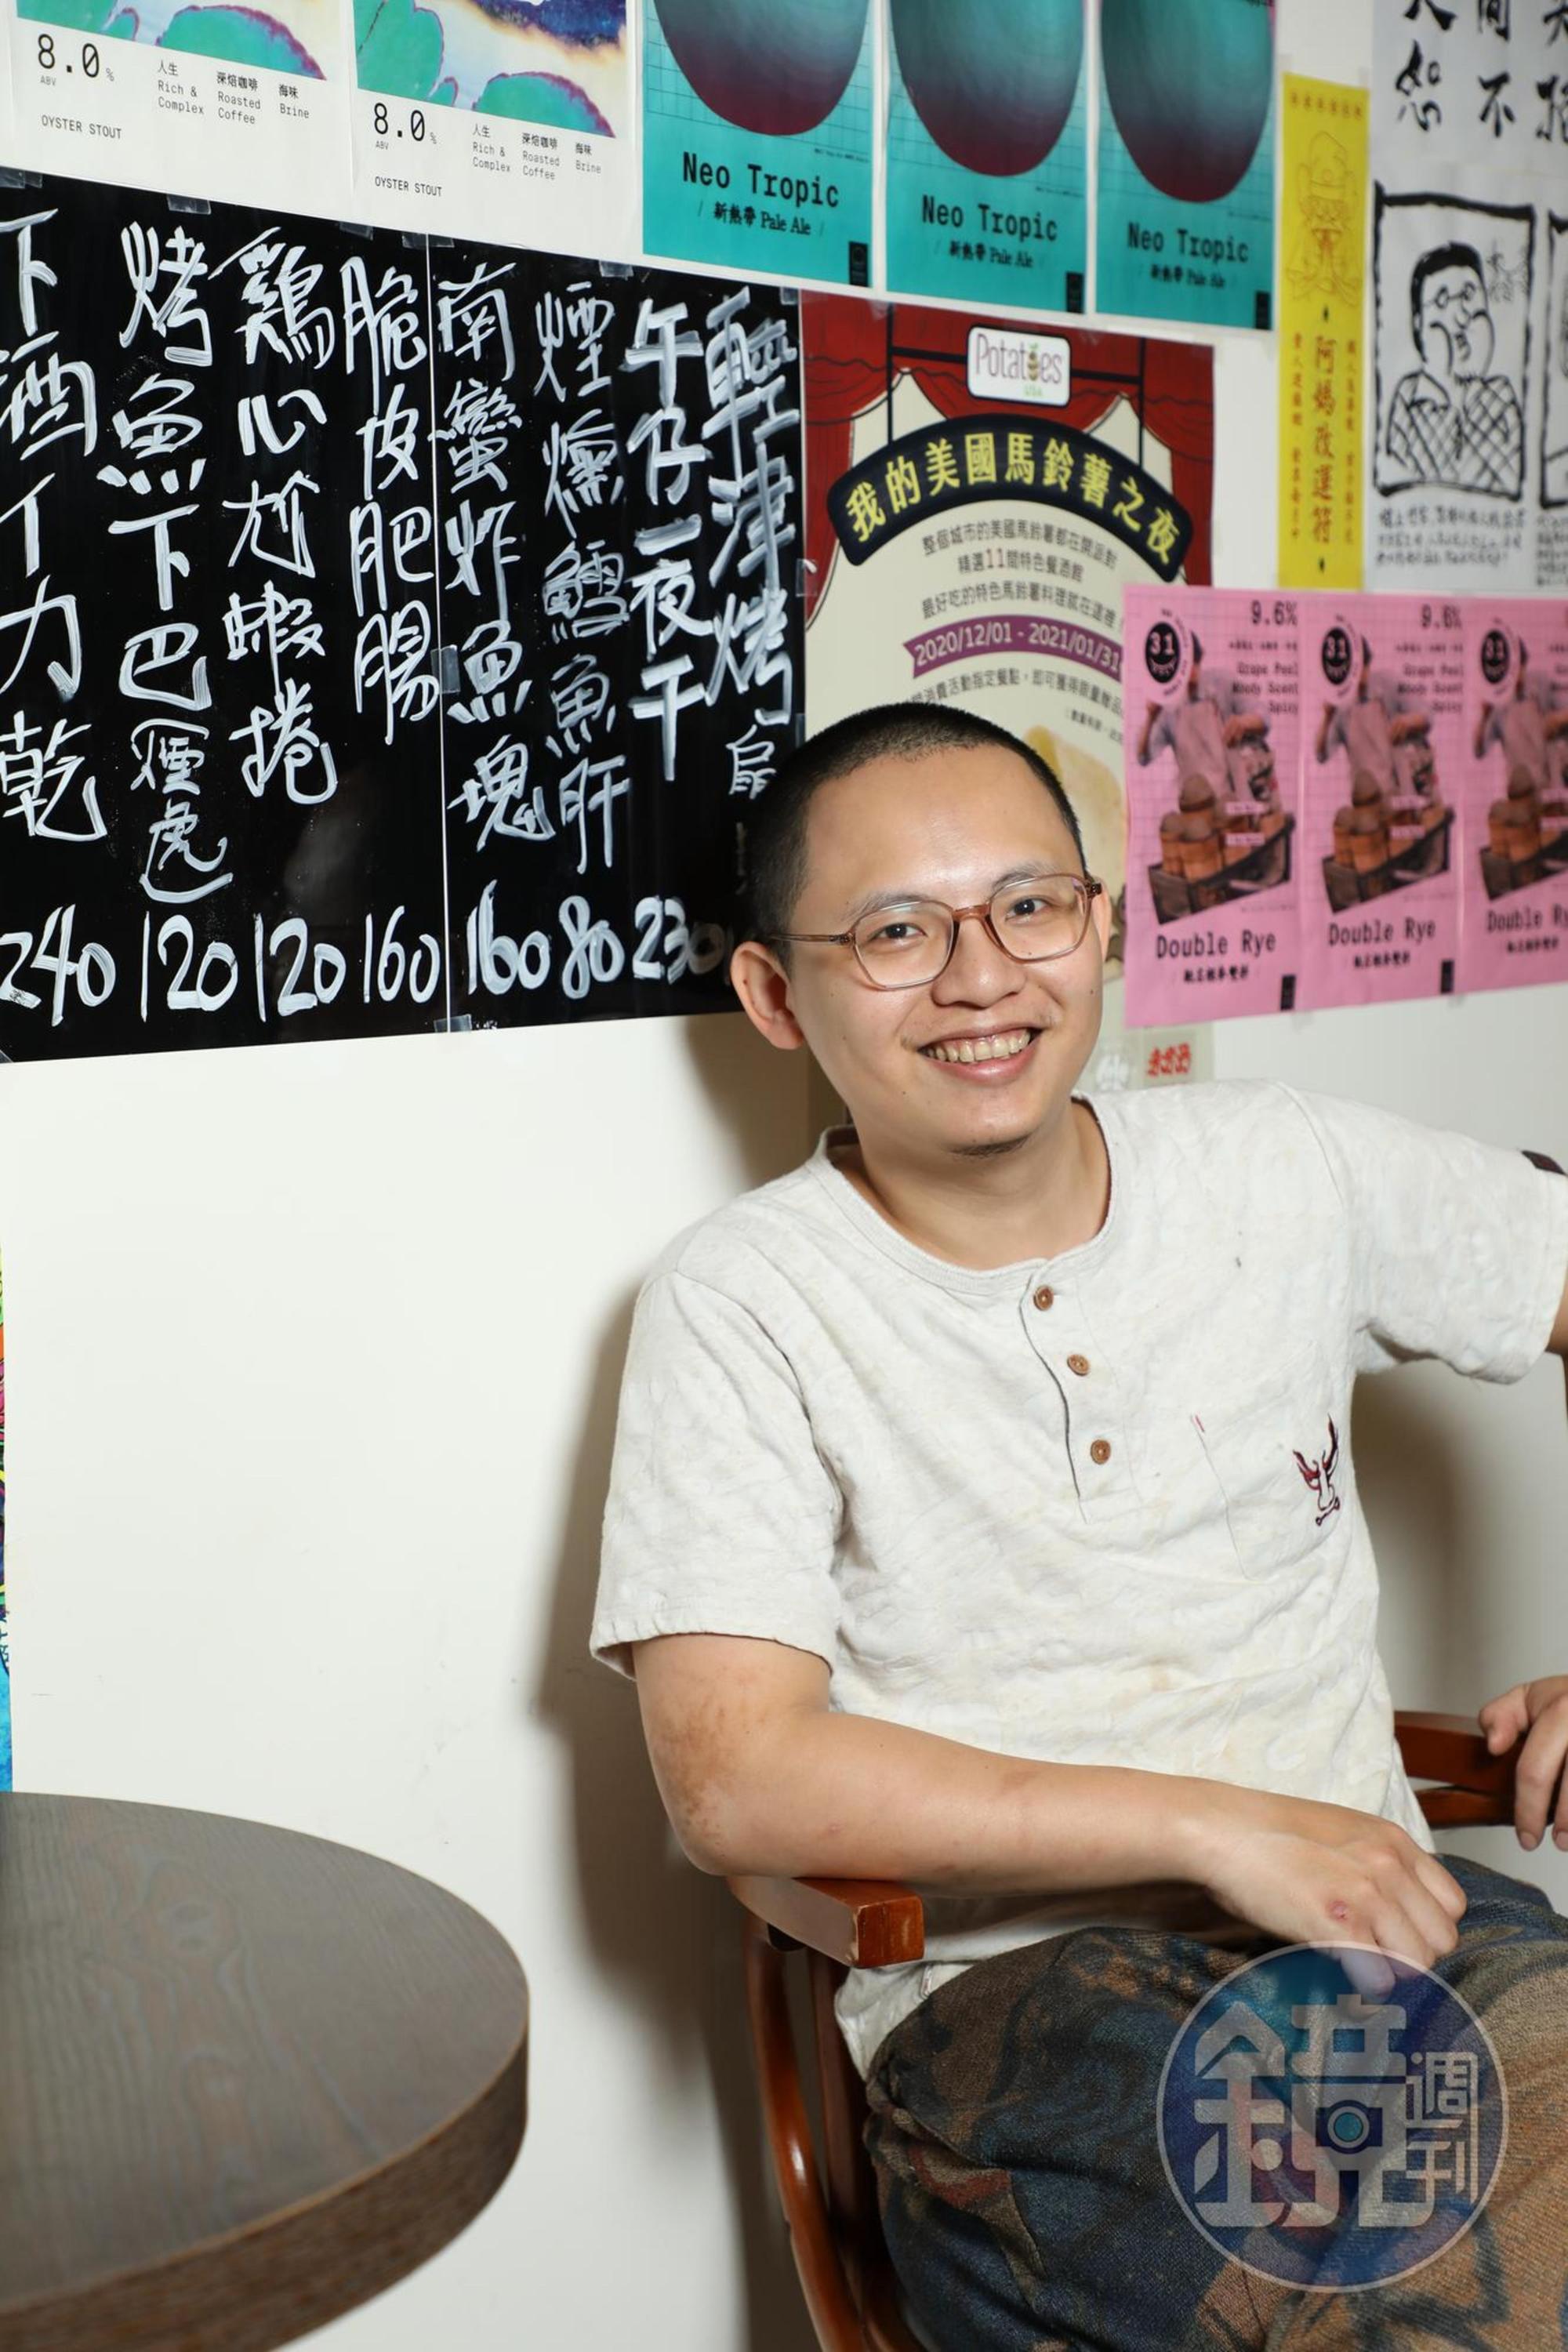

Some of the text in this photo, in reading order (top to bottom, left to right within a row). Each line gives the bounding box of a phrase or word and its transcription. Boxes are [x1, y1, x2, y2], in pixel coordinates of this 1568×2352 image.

[40, 75, 57, 86] ABV
[158, 60, 178, 76] 人生
[158, 80, 198, 97] Rich &
[217, 91, 261, 110] Roasted
[158, 96, 205, 115] Complex
[218, 107, 256, 125] Coffee
[279, 103, 310, 119] Brine
[41, 114, 122, 139] OYSTER STOUT
[472, 123, 491, 138] 人生
[472, 141, 495, 155] Rich
[522, 151, 561, 167] Roasted
[472, 156, 511, 172] Complex
[522, 165, 556, 180] Coffee
[575, 159, 602, 174] Brine
[375, 176, 442, 197] OYSTER STOUT
[683, 151, 839, 209] Neo Tropic
[713, 200, 811, 236] 新熱帶 Pale Ale
[921, 194, 1058, 243] Neo Tropic
[1127, 221, 1249, 265] Neo Tropic
[341, 256, 440, 745] 脆皮肥腸
[846, 431, 1180, 565] 我的美國馬鈴薯之夜
[1251, 599, 1298, 626] 9.6%
[915, 622, 1013, 666] 2020/12/01
[1029, 622, 1120, 673] 2021/01/31
[467, 880, 550, 996] 160
[1156, 928, 1276, 959] Double Rye
[1328, 916, 1436, 947] Double Rye
[364, 906, 441, 1004] 160
[558, 895, 626, 1000] 80
[0, 905, 115, 1026] 240
[141, 912, 238, 1022] 120
[254, 913, 346, 1021] 120
